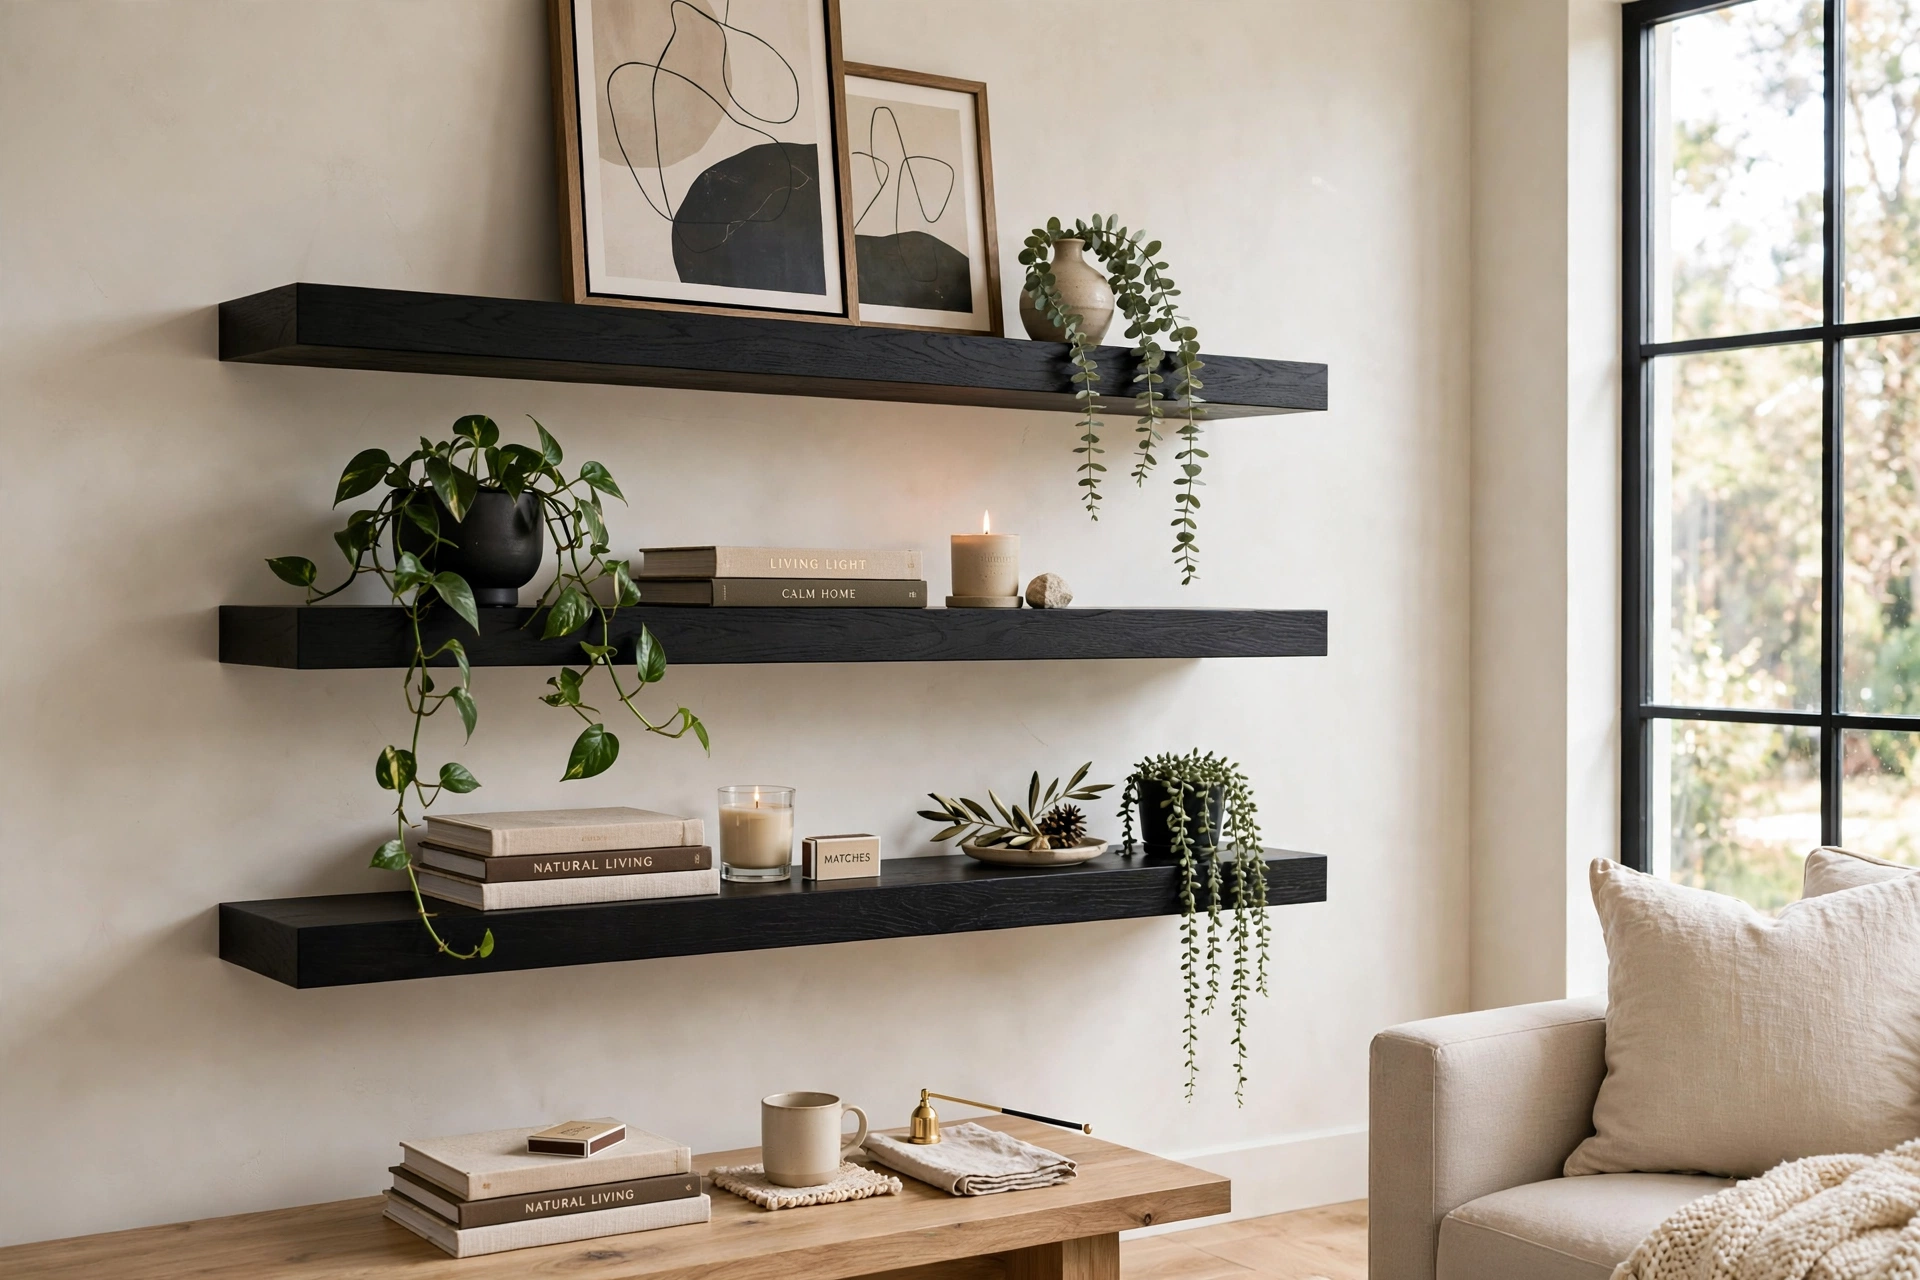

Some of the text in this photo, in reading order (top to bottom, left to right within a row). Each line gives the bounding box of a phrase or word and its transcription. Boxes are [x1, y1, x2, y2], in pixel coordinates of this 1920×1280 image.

[770, 558, 867, 570] LIVING LIGHT
[781, 588, 856, 599] CALM HOME
[824, 852, 871, 864] MATCHES
[533, 856, 654, 874] NATURAL LIVING
[525, 1189, 635, 1214] NATURAL LIVING
